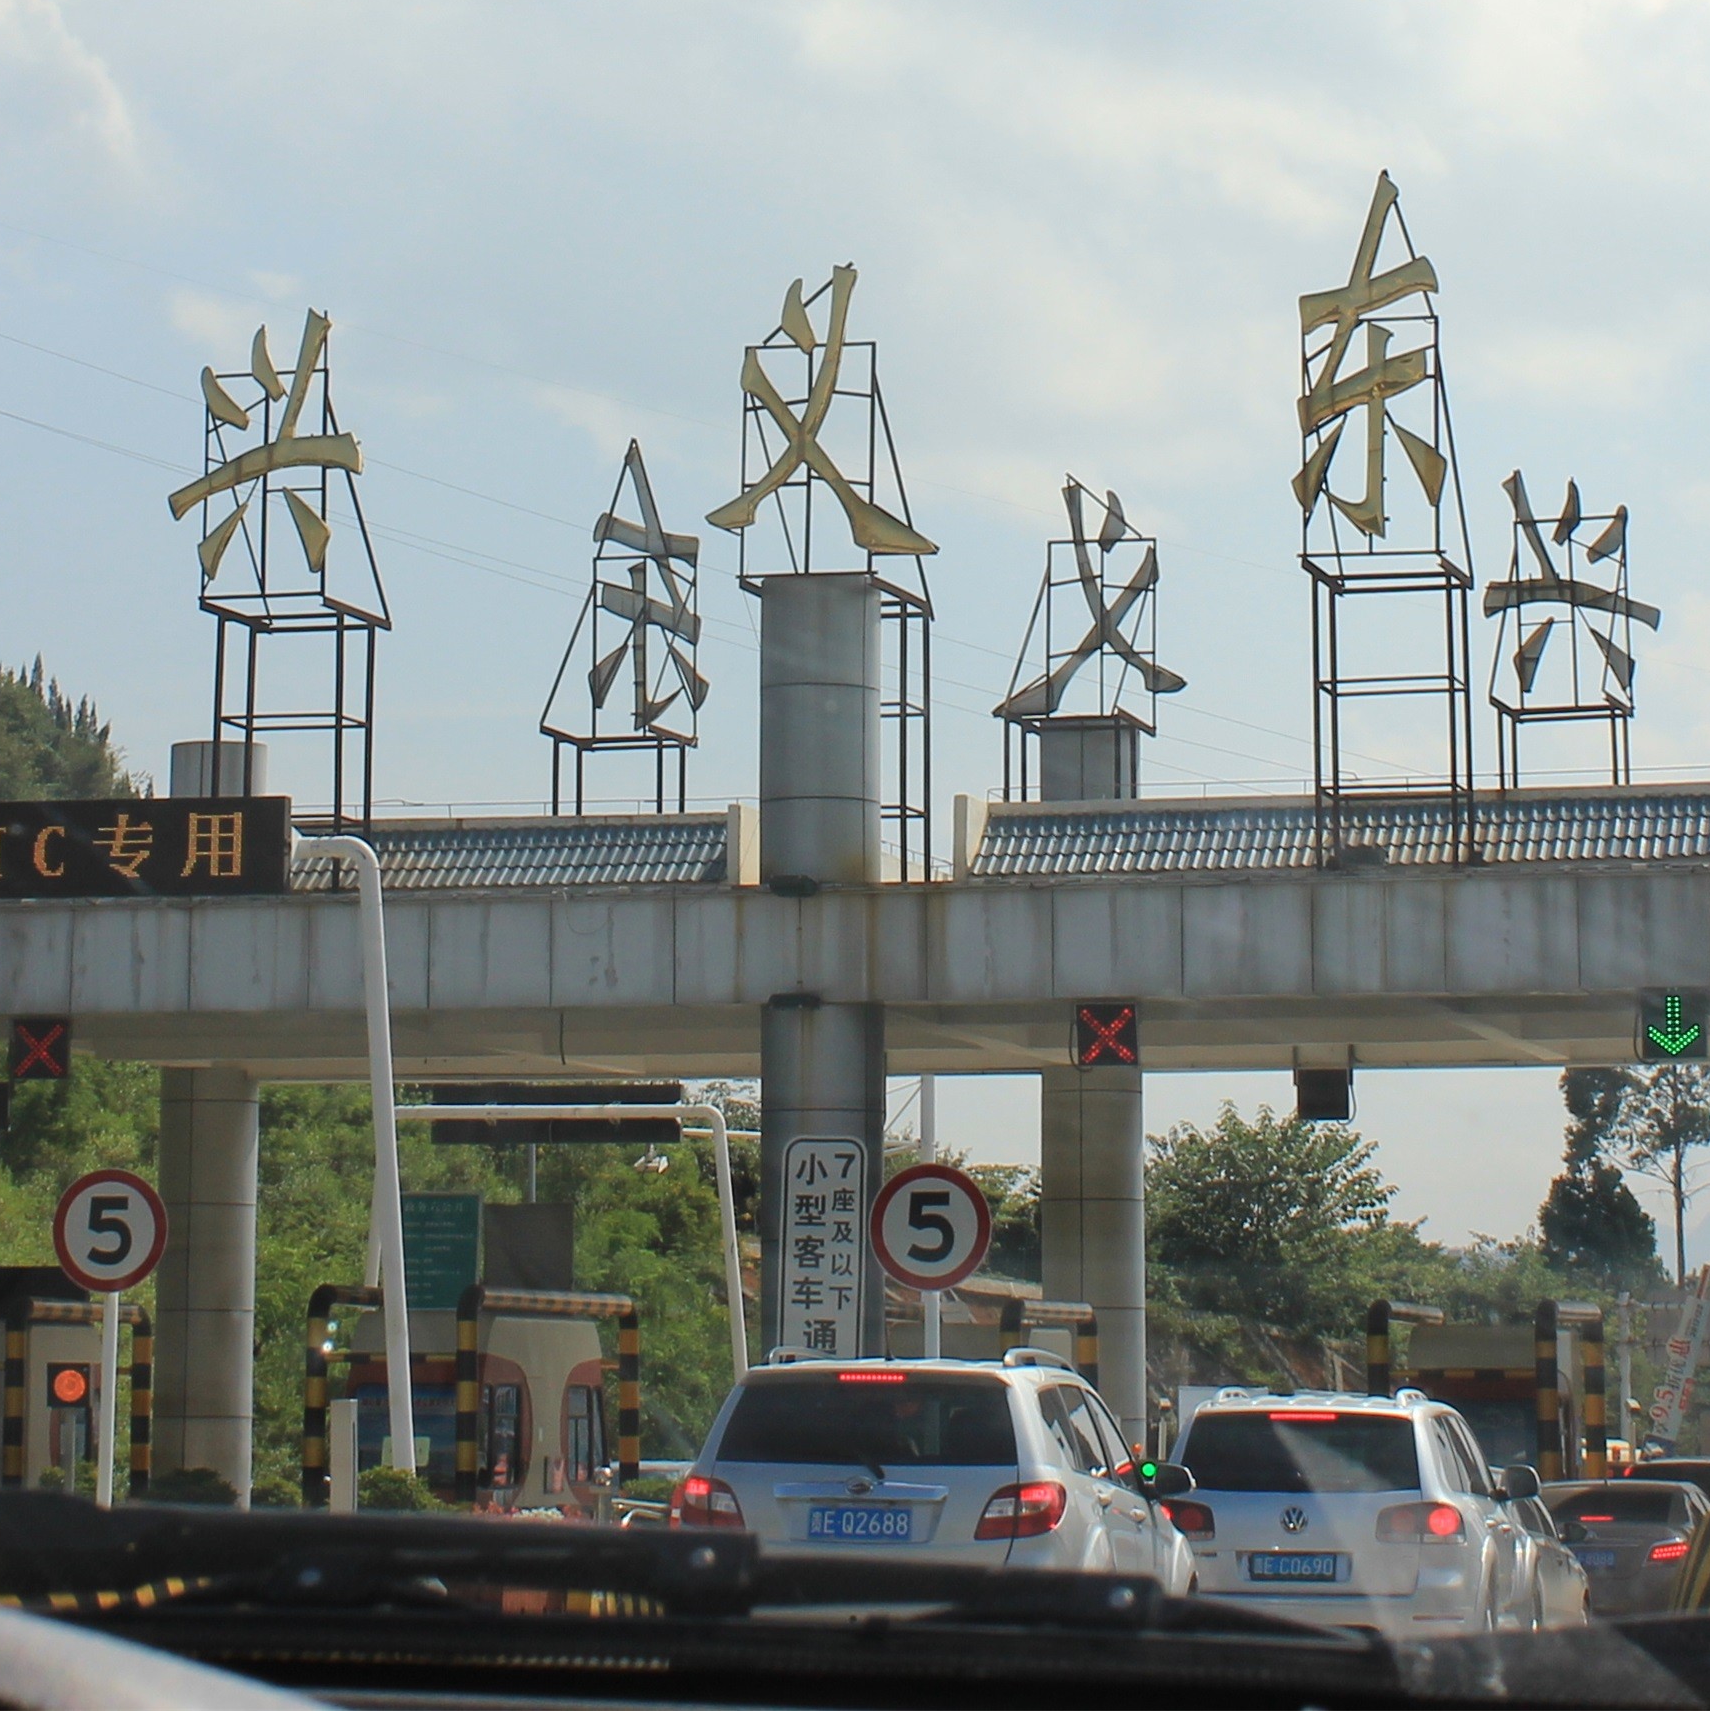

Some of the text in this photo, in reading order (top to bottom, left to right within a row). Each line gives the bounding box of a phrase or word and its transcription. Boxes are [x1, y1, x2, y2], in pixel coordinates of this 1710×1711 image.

[86, 1196, 133, 1266] 5
[791, 1152, 829, 1311] 小型客车
[829, 1153, 857, 1311] 7座及以下
[907, 1191, 955, 1263] 5
